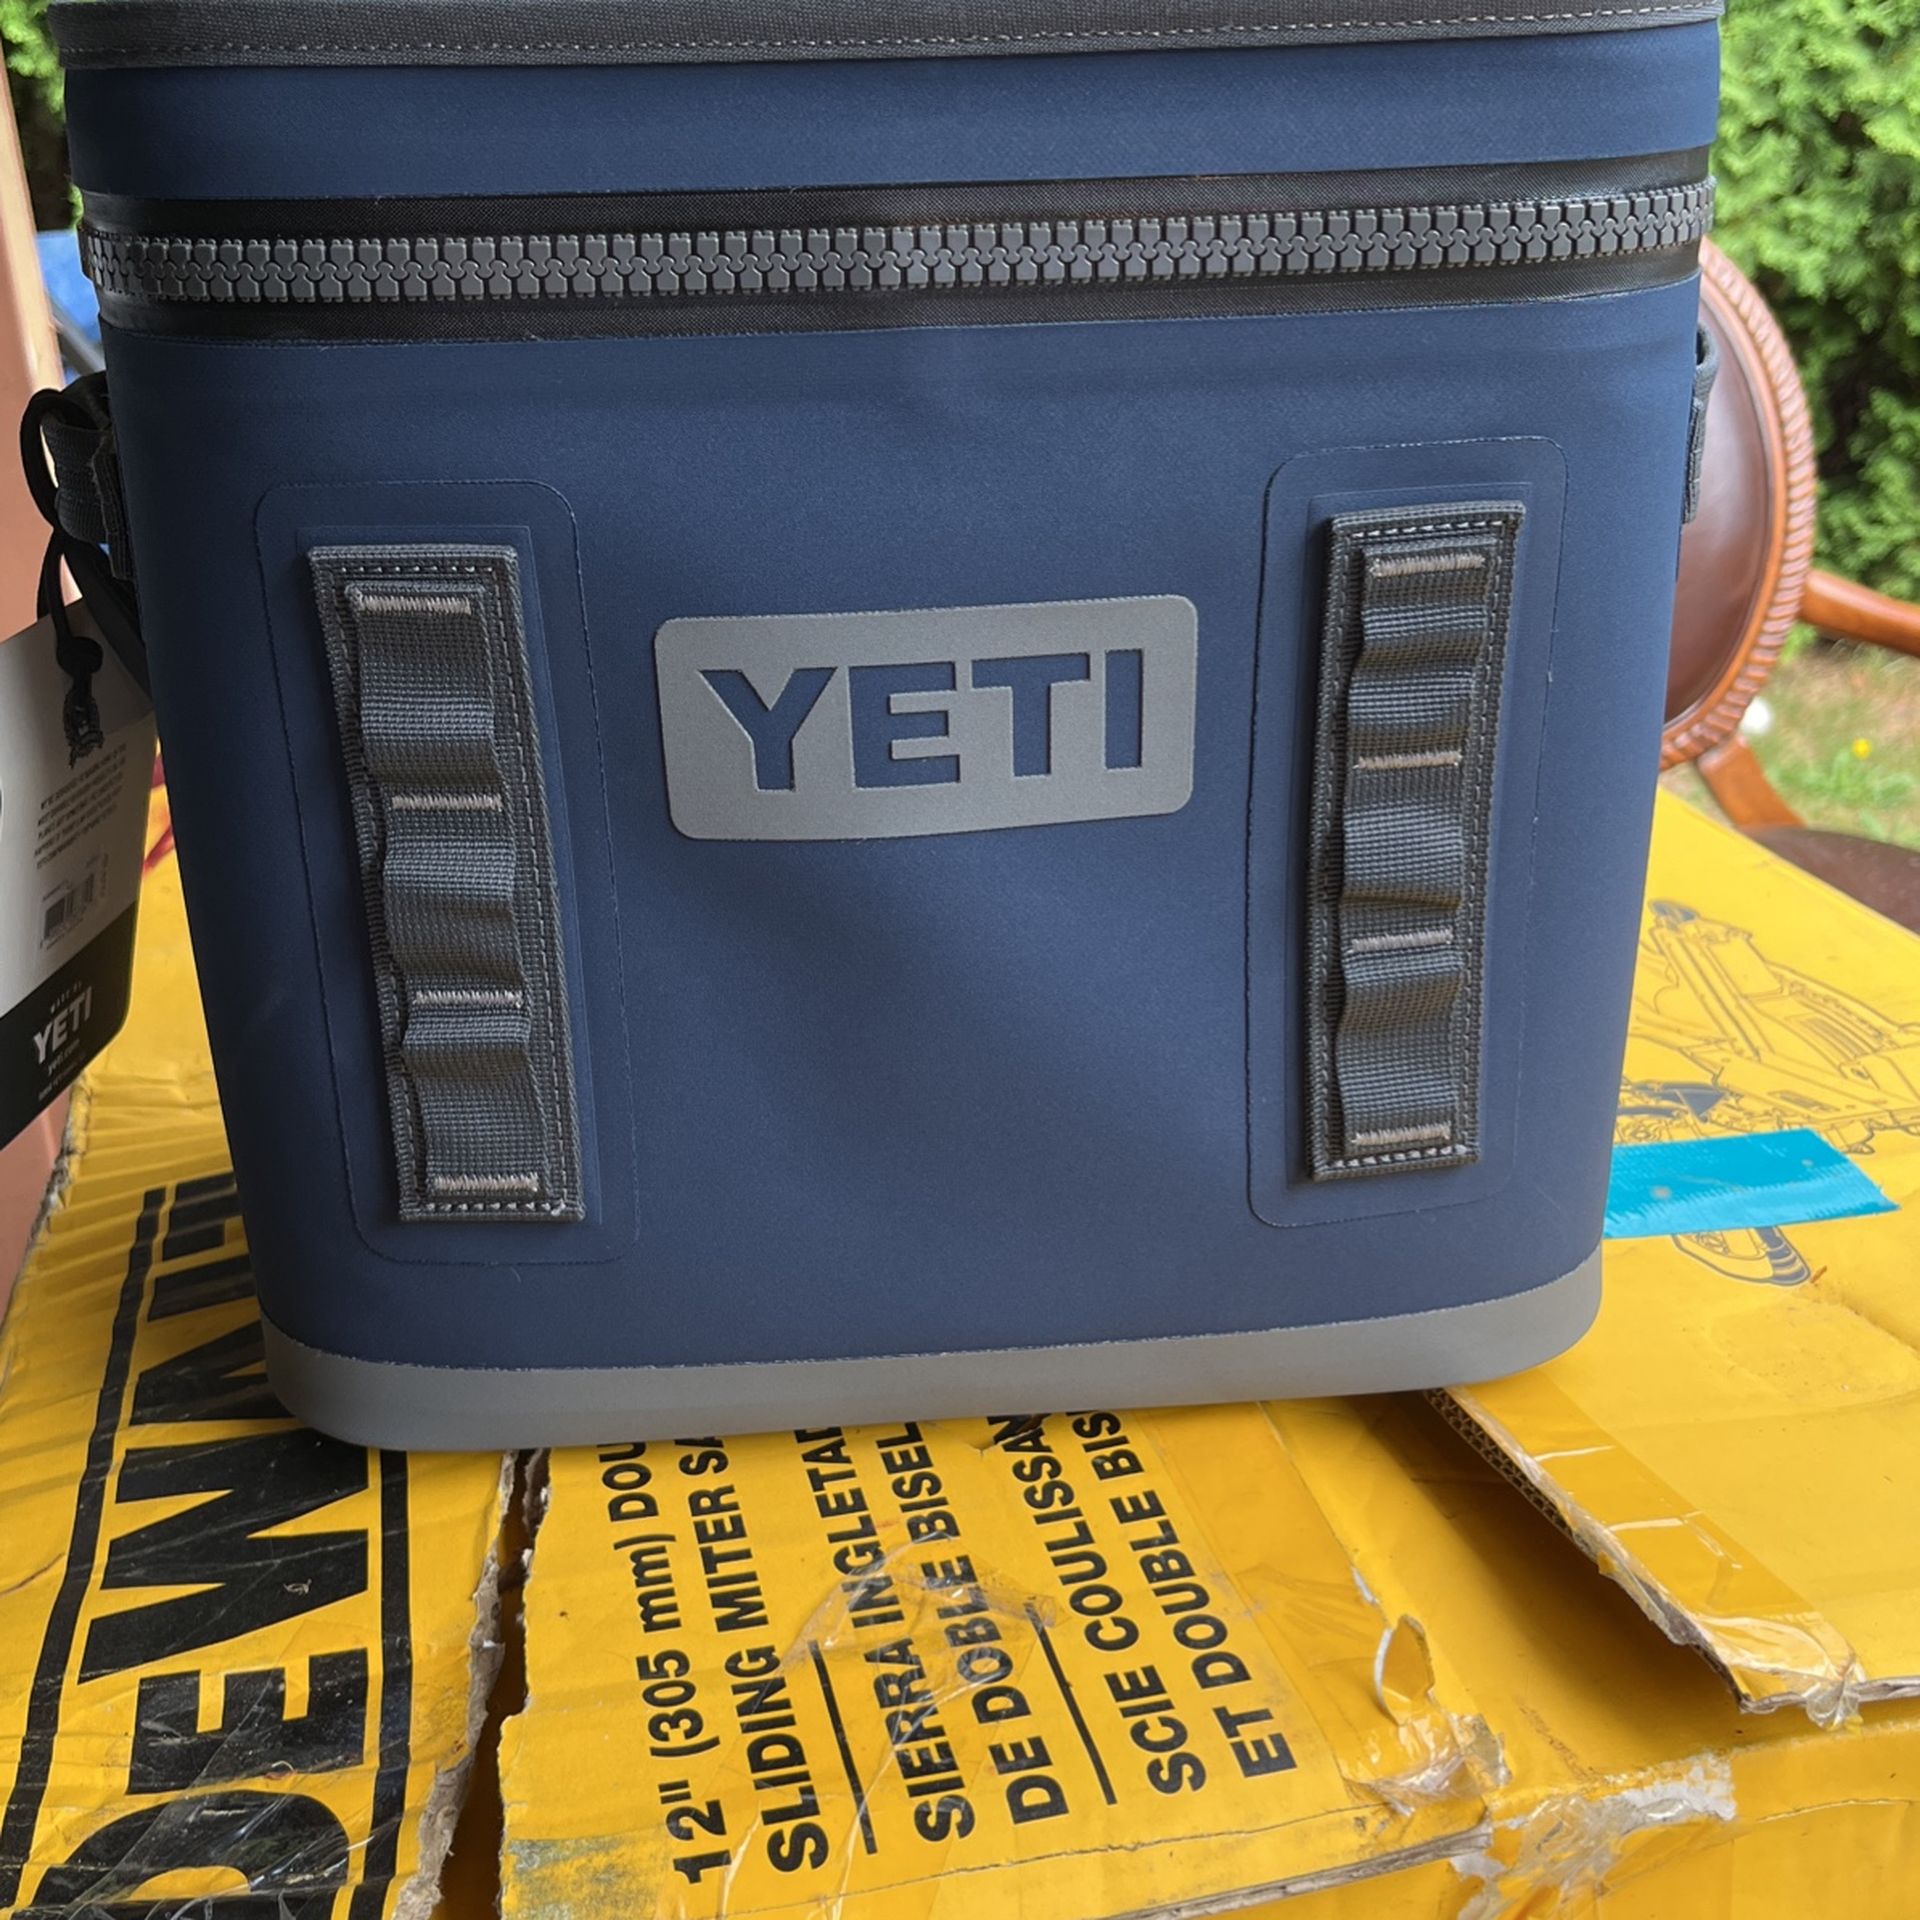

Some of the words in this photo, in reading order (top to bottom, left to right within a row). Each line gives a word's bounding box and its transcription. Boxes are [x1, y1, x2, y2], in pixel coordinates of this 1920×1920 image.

[700, 648, 1142, 792] YETI
[33, 986, 93, 1065] YETI
[876, 1421, 961, 1544] BISEL
[1066, 1410, 1145, 1481] BIS
[613, 1534, 682, 1633] mm)
[688, 1484, 769, 1633] MITER
[1109, 1490, 1252, 1689] DOUBLE
[922, 1555, 1032, 1724] DOBLE
[636, 1649, 720, 1757] (305
[724, 1645, 829, 1872] SLIDING
[864, 1638, 975, 1842] SIERRA
[1104, 1665, 1207, 1794] SCIE
[1213, 1706, 1297, 1778] ET
[658, 1779, 732, 1884] 12"
[989, 1736, 1070, 1825] DE
